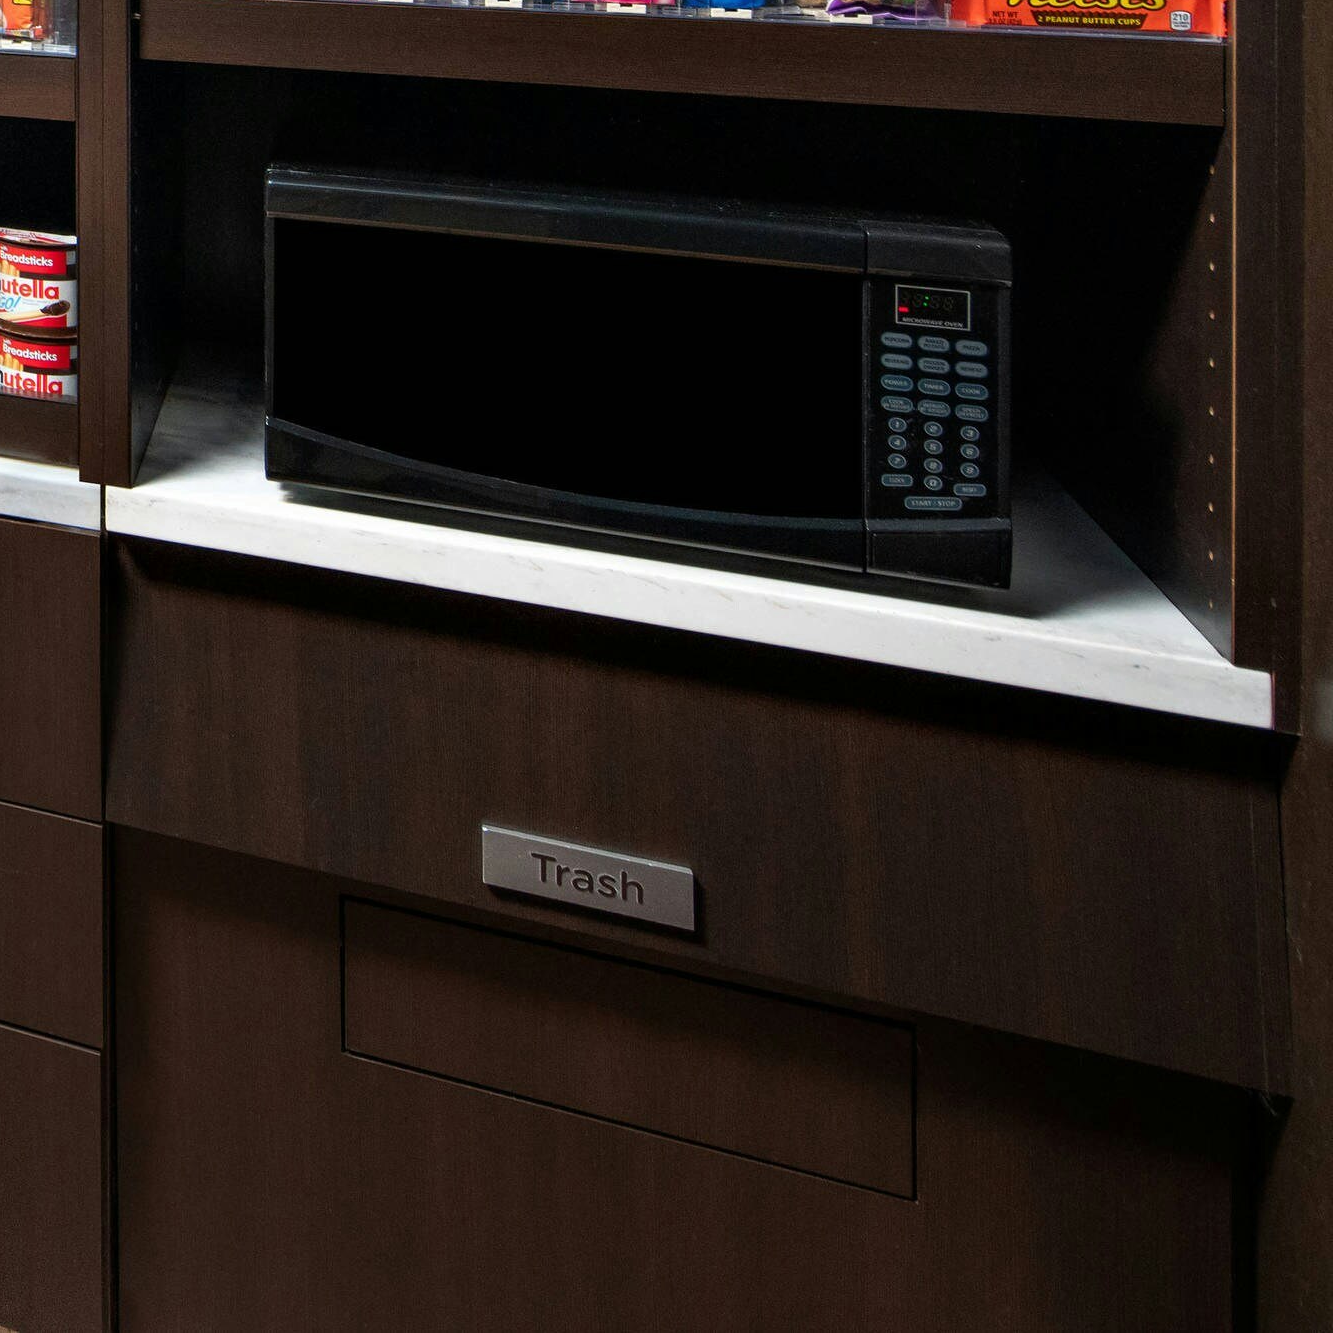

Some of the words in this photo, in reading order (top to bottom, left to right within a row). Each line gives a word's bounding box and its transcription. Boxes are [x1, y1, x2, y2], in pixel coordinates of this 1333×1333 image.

[1037, 15, 1044, 23] 2
[1045, 15, 1080, 24] PEANUT
[1083, 17, 1115, 25] BUTTER
[1117, 17, 1142, 26] CUPS
[1172, 12, 1189, 22] 210
[0, 251, 54, 268] Breadsticks
[2, 345, 58, 363] Breadsticks
[530, 851, 644, 905] Trash
